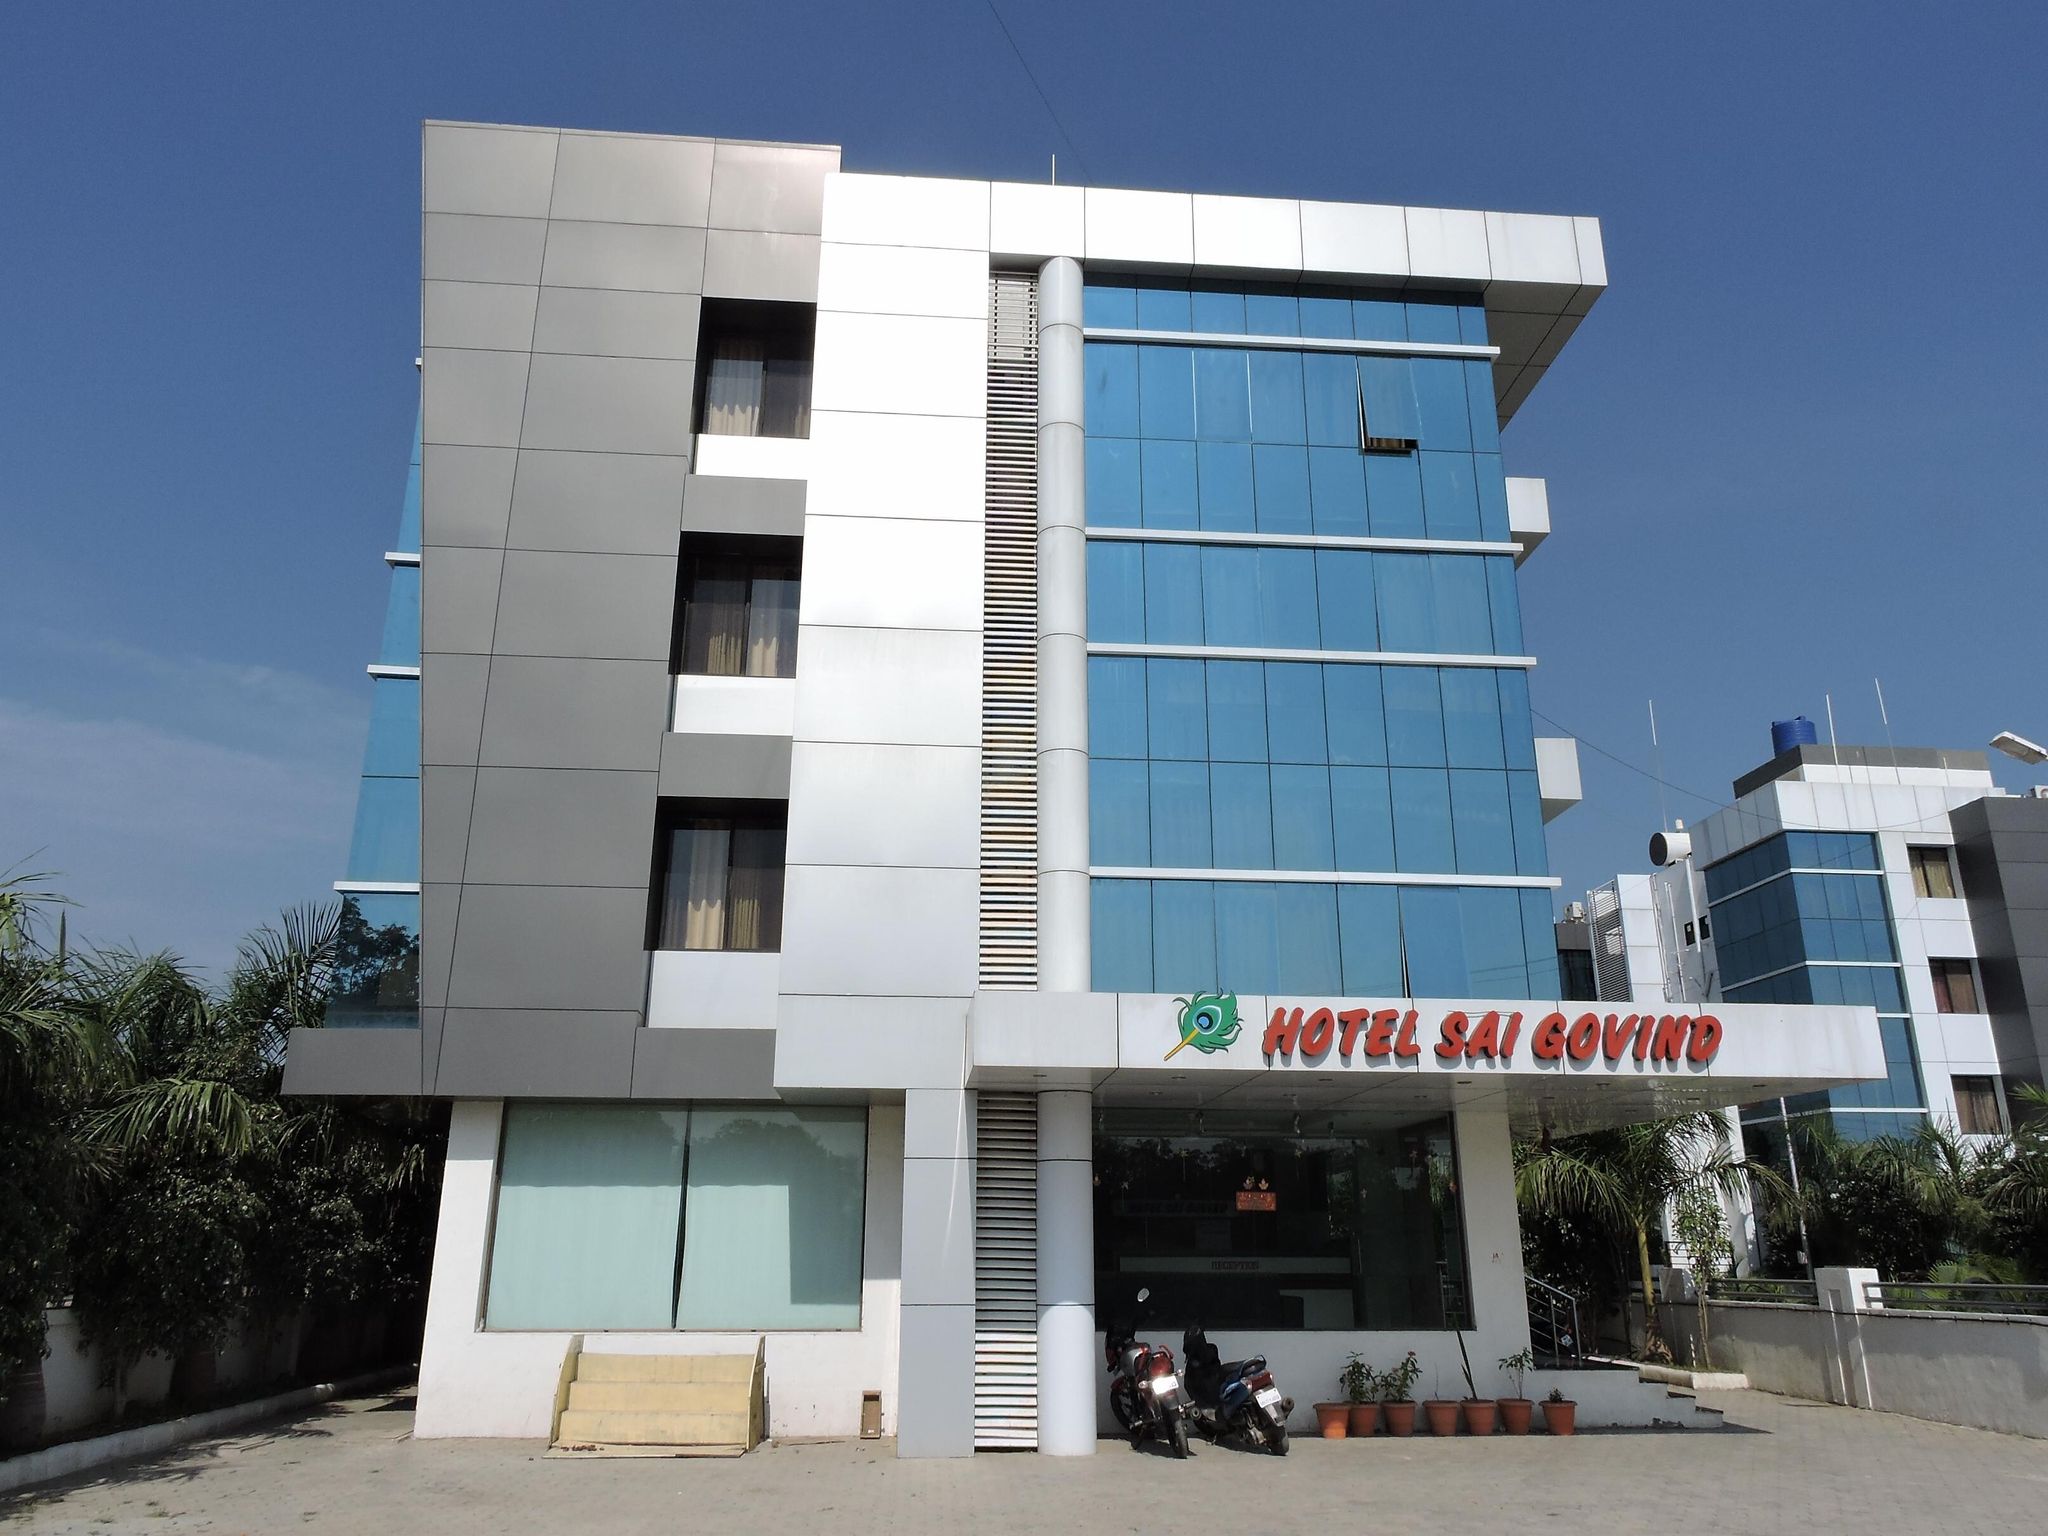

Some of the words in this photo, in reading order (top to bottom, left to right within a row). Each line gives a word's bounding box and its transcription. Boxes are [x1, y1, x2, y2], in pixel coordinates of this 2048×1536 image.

[1263, 1007, 1421, 1057] HOTEL
[1434, 1010, 1523, 1058] SAI
[1531, 1012, 1723, 1062] GOVIND
